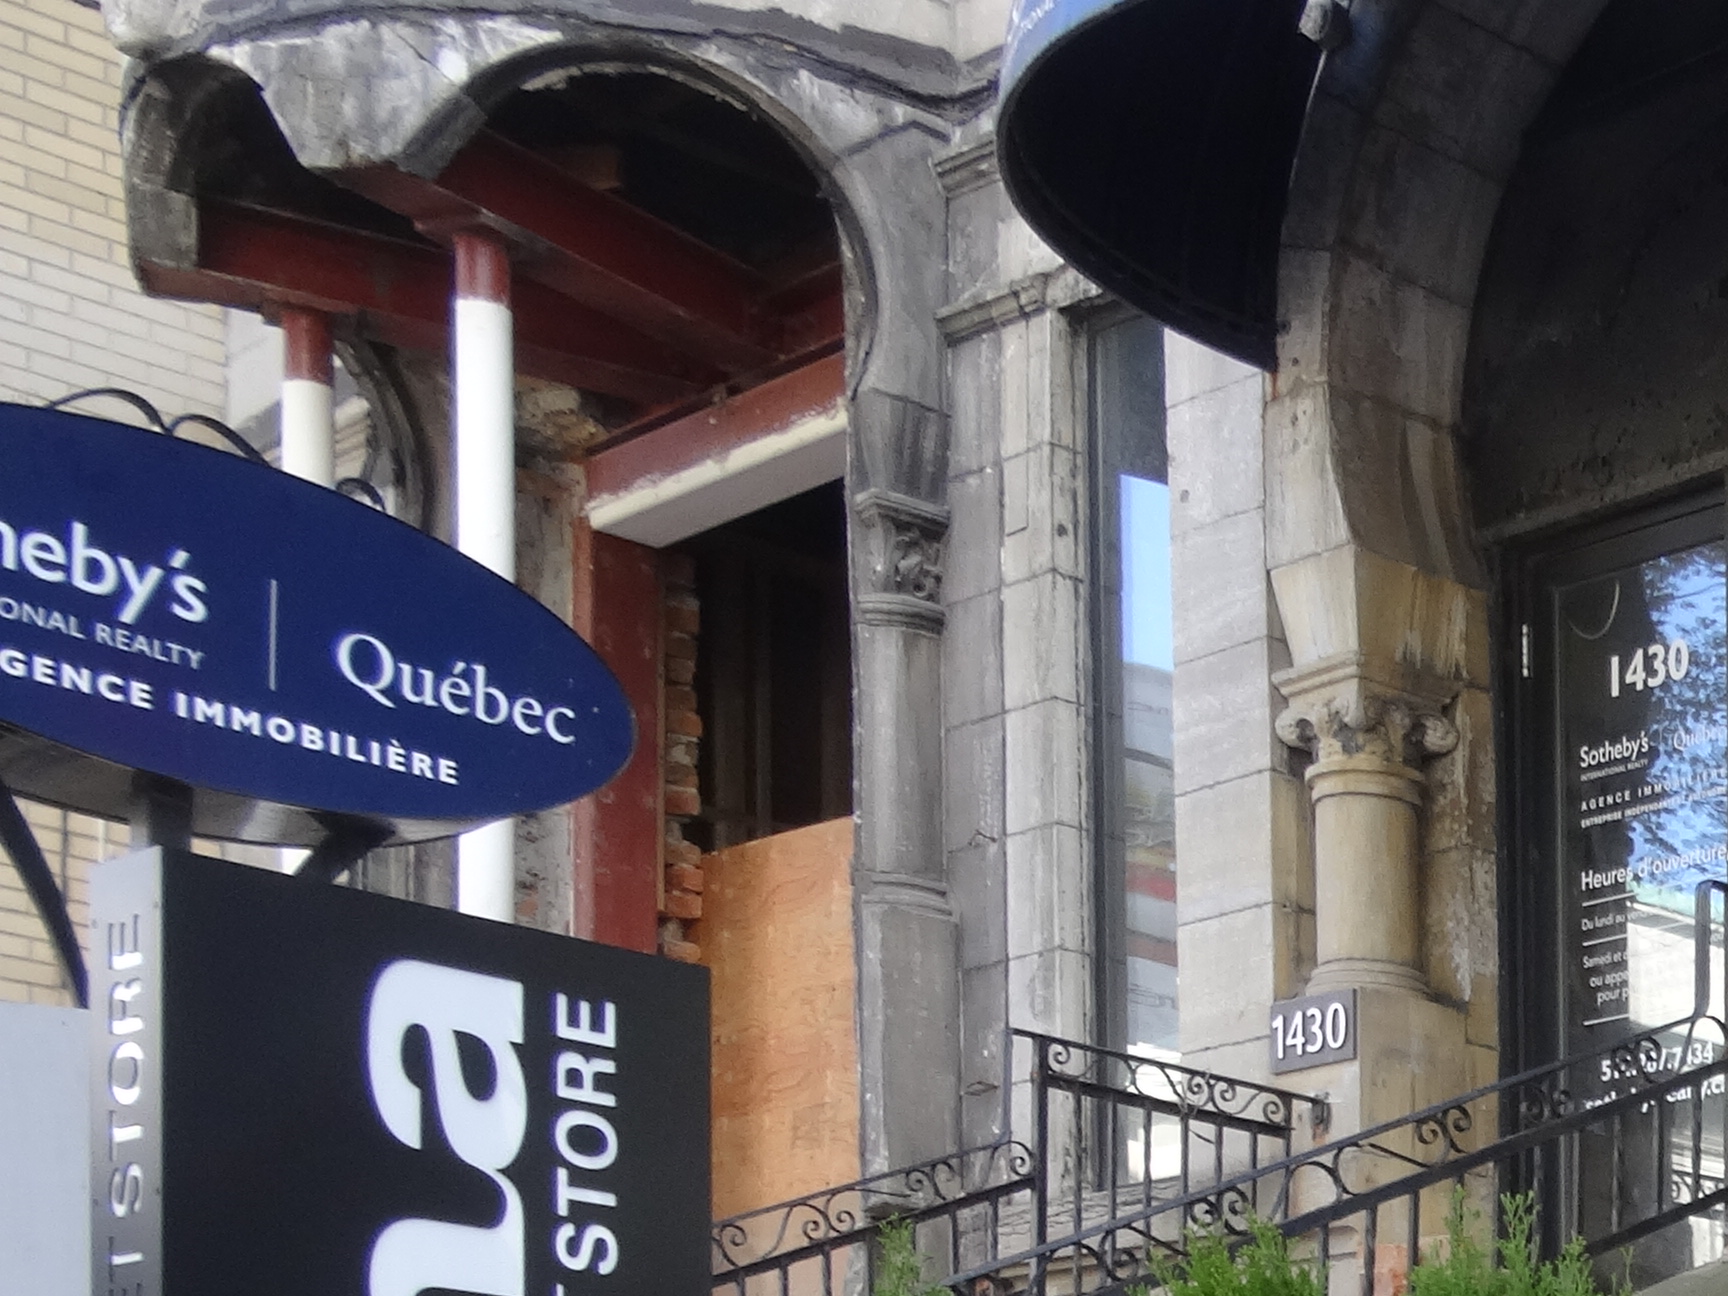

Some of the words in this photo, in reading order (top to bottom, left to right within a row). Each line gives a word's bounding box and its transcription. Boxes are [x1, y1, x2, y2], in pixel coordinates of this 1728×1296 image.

[94, 622, 206, 671] REALTY
[1611, 637, 1690, 698] 1430
[336, 632, 577, 745] Québec
[173, 691, 460, 786] IMMOBILIÈRE
[1580, 730, 1649, 769] Sotheby's
[1580, 789, 1631, 812] AGENCE
[1580, 810, 1623, 829] ENTREPRISE
[1580, 866, 1634, 892] Heures
[1638, 847, 1727, 878] d'ouverture
[1581, 918, 1594, 932] Du
[1582, 951, 1613, 969] Samedi
[1271, 1002, 1347, 1060] 1430
[108, 913, 145, 1219] STORE
[553, 991, 620, 1276] STORE
